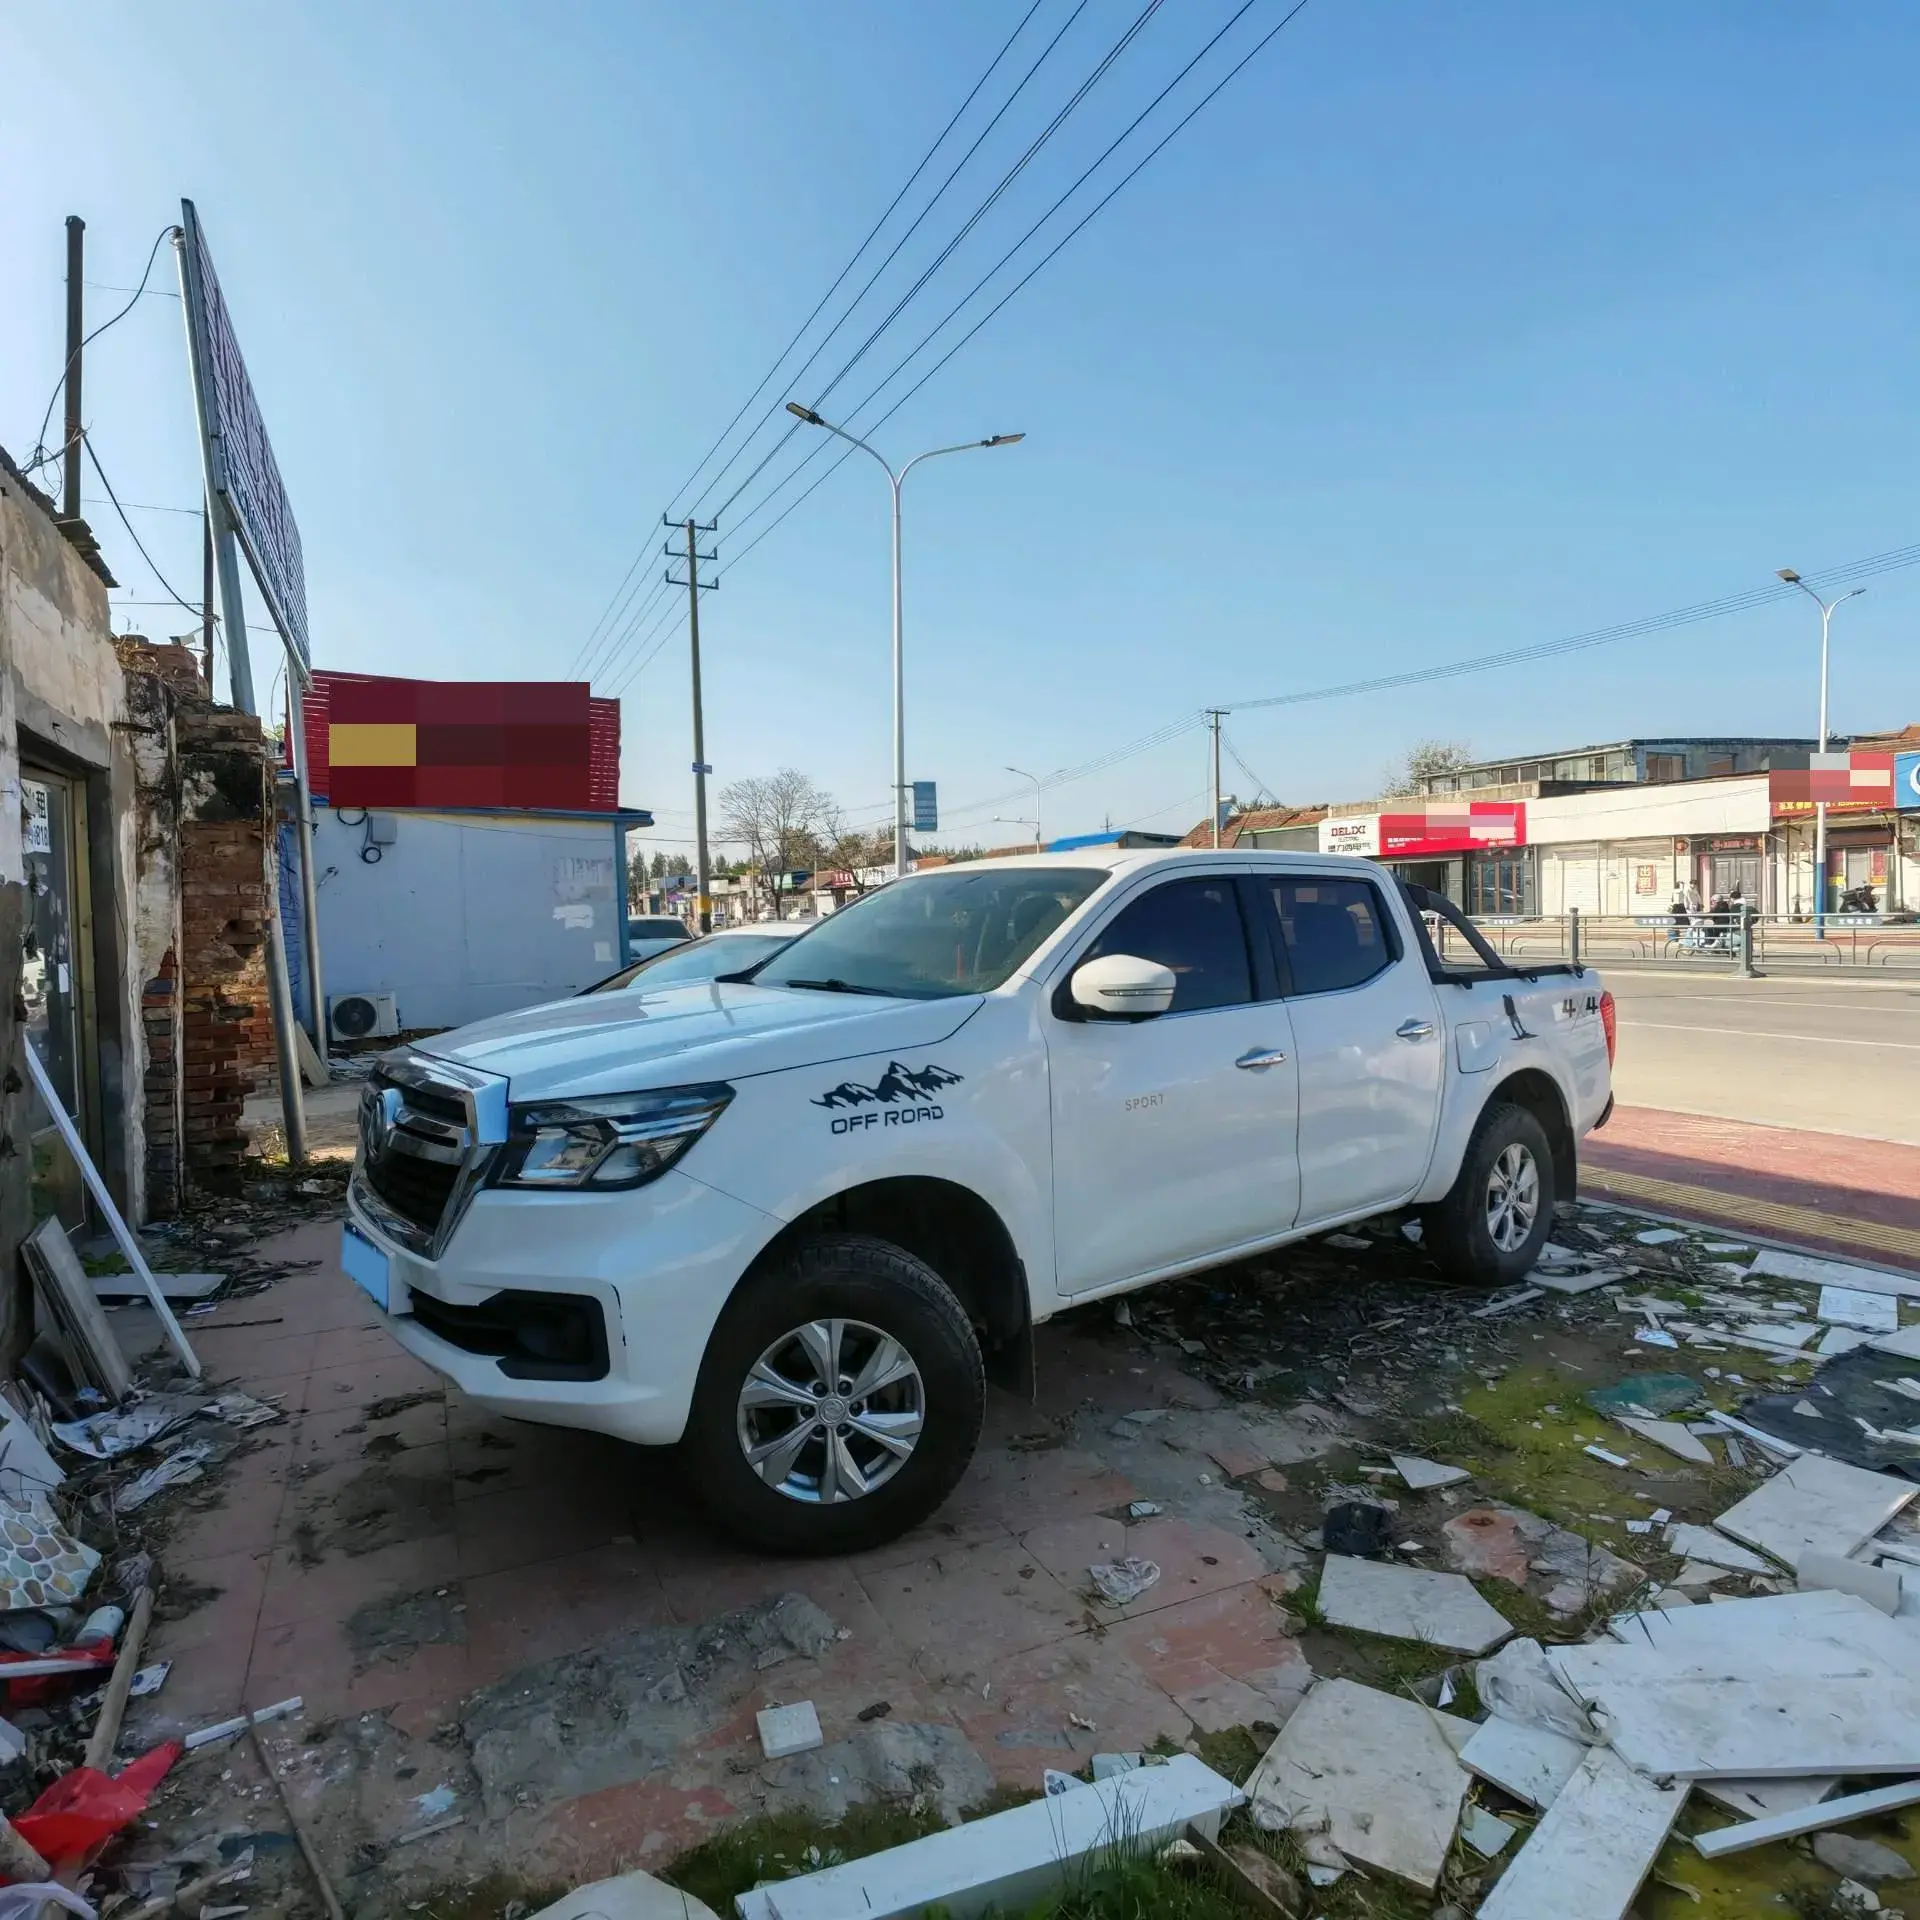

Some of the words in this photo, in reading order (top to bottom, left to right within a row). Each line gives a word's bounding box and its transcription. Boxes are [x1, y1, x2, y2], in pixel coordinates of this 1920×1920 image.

[1331, 825, 1366, 837] DELIXI
[1125, 1093, 1164, 1111] SPORT
[831, 1113, 878, 1135] OFF
[884, 1106, 944, 1126] ROAD
